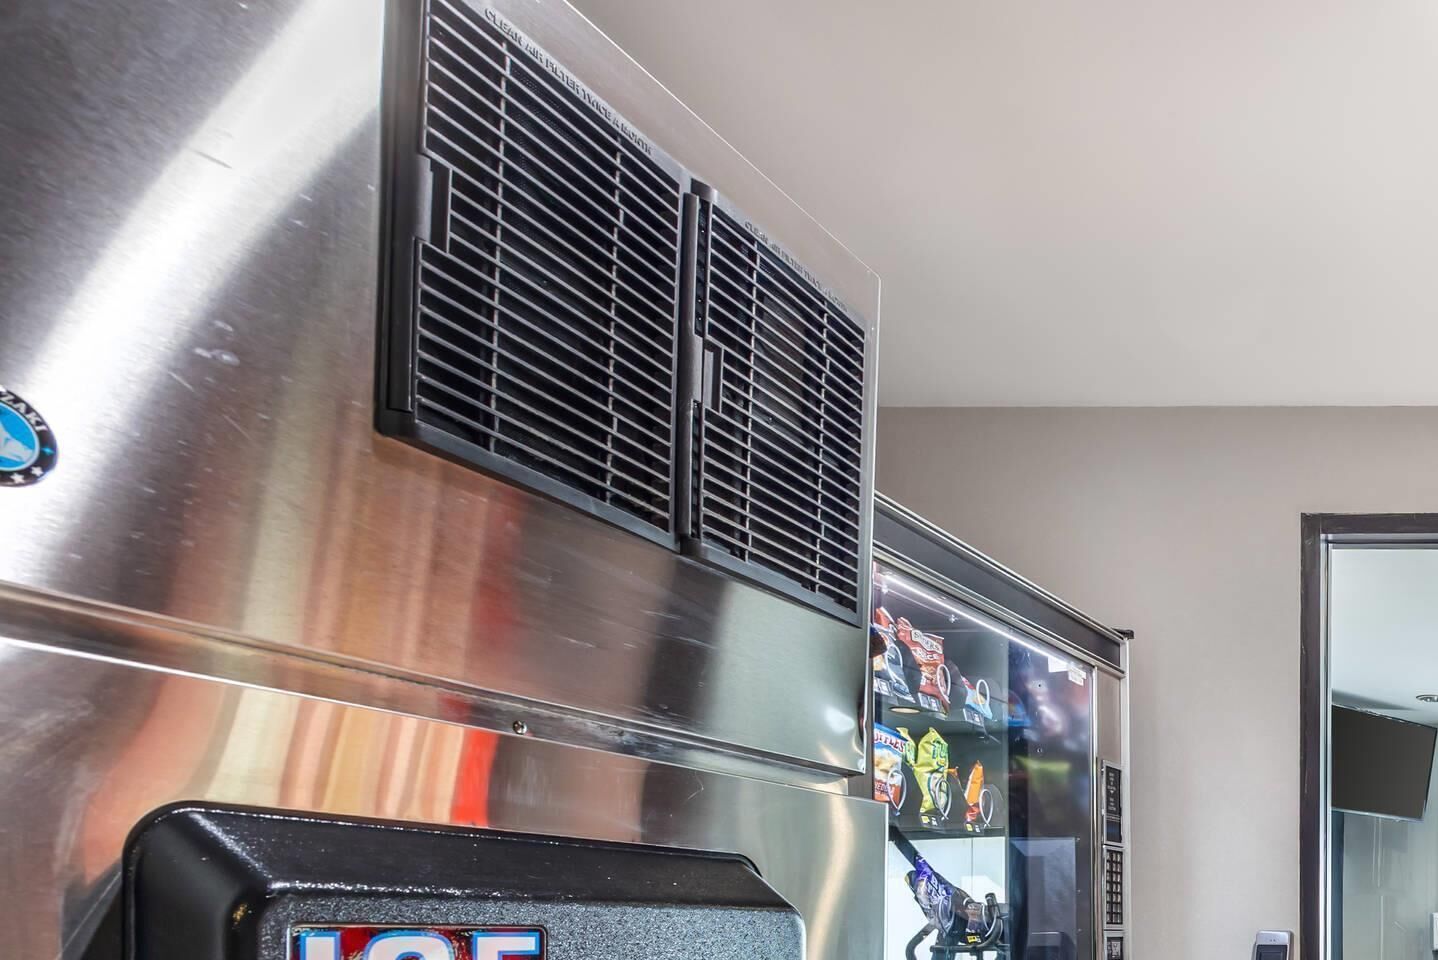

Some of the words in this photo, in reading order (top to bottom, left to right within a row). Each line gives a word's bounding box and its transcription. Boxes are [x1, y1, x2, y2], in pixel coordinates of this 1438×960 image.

[484, 7, 523, 47] CLEAN
[524, 43, 544, 64] AIR
[545, 58, 580, 95] FILTER
[581, 88, 612, 121] TWICE
[620, 122, 652, 155] MONTH
